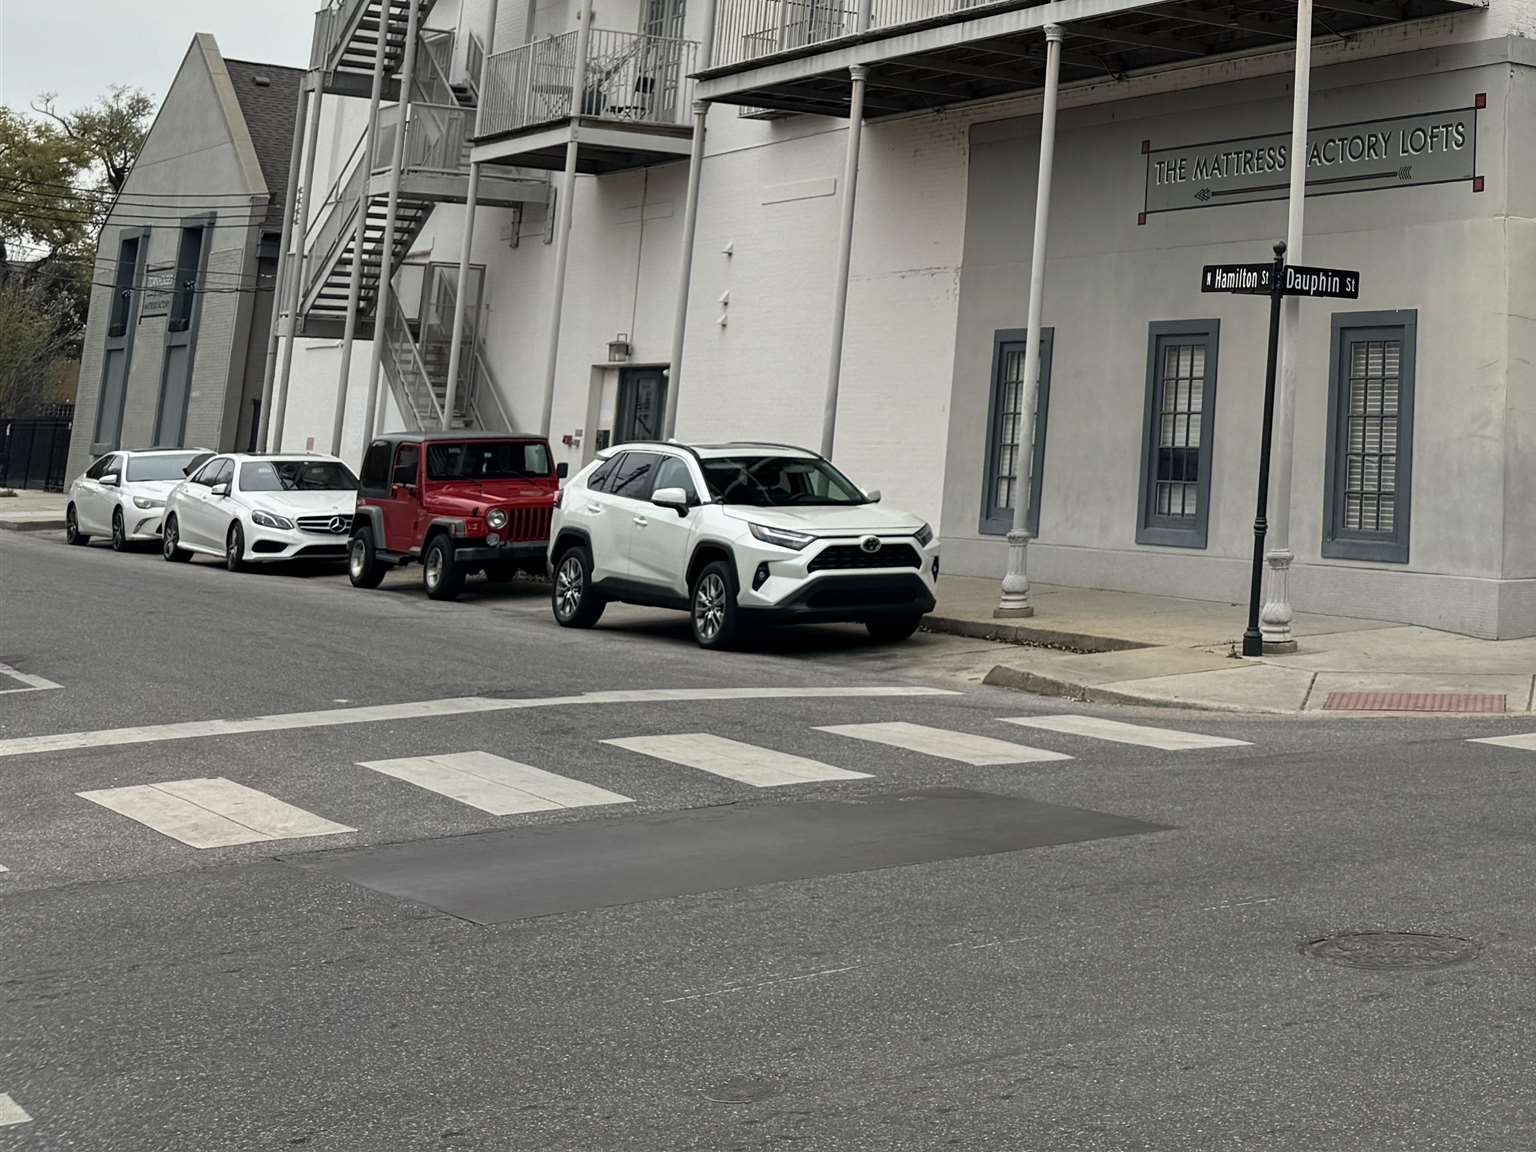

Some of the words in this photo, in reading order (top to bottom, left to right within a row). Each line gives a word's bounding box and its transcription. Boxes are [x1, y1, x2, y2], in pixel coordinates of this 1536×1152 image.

[1154, 157, 1188, 186] THE
[1191, 144, 1288, 182] MATTRESS
[1306, 130, 1393, 168] ACTORY
[1399, 121, 1467, 157] LOFTS
[1206, 271, 1212, 286] N
[1214, 268, 1258, 289] Hamilton
[1261, 270, 1269, 286] St
[1286, 268, 1340, 296] Dauphin
[1345, 277, 1356, 293] St
